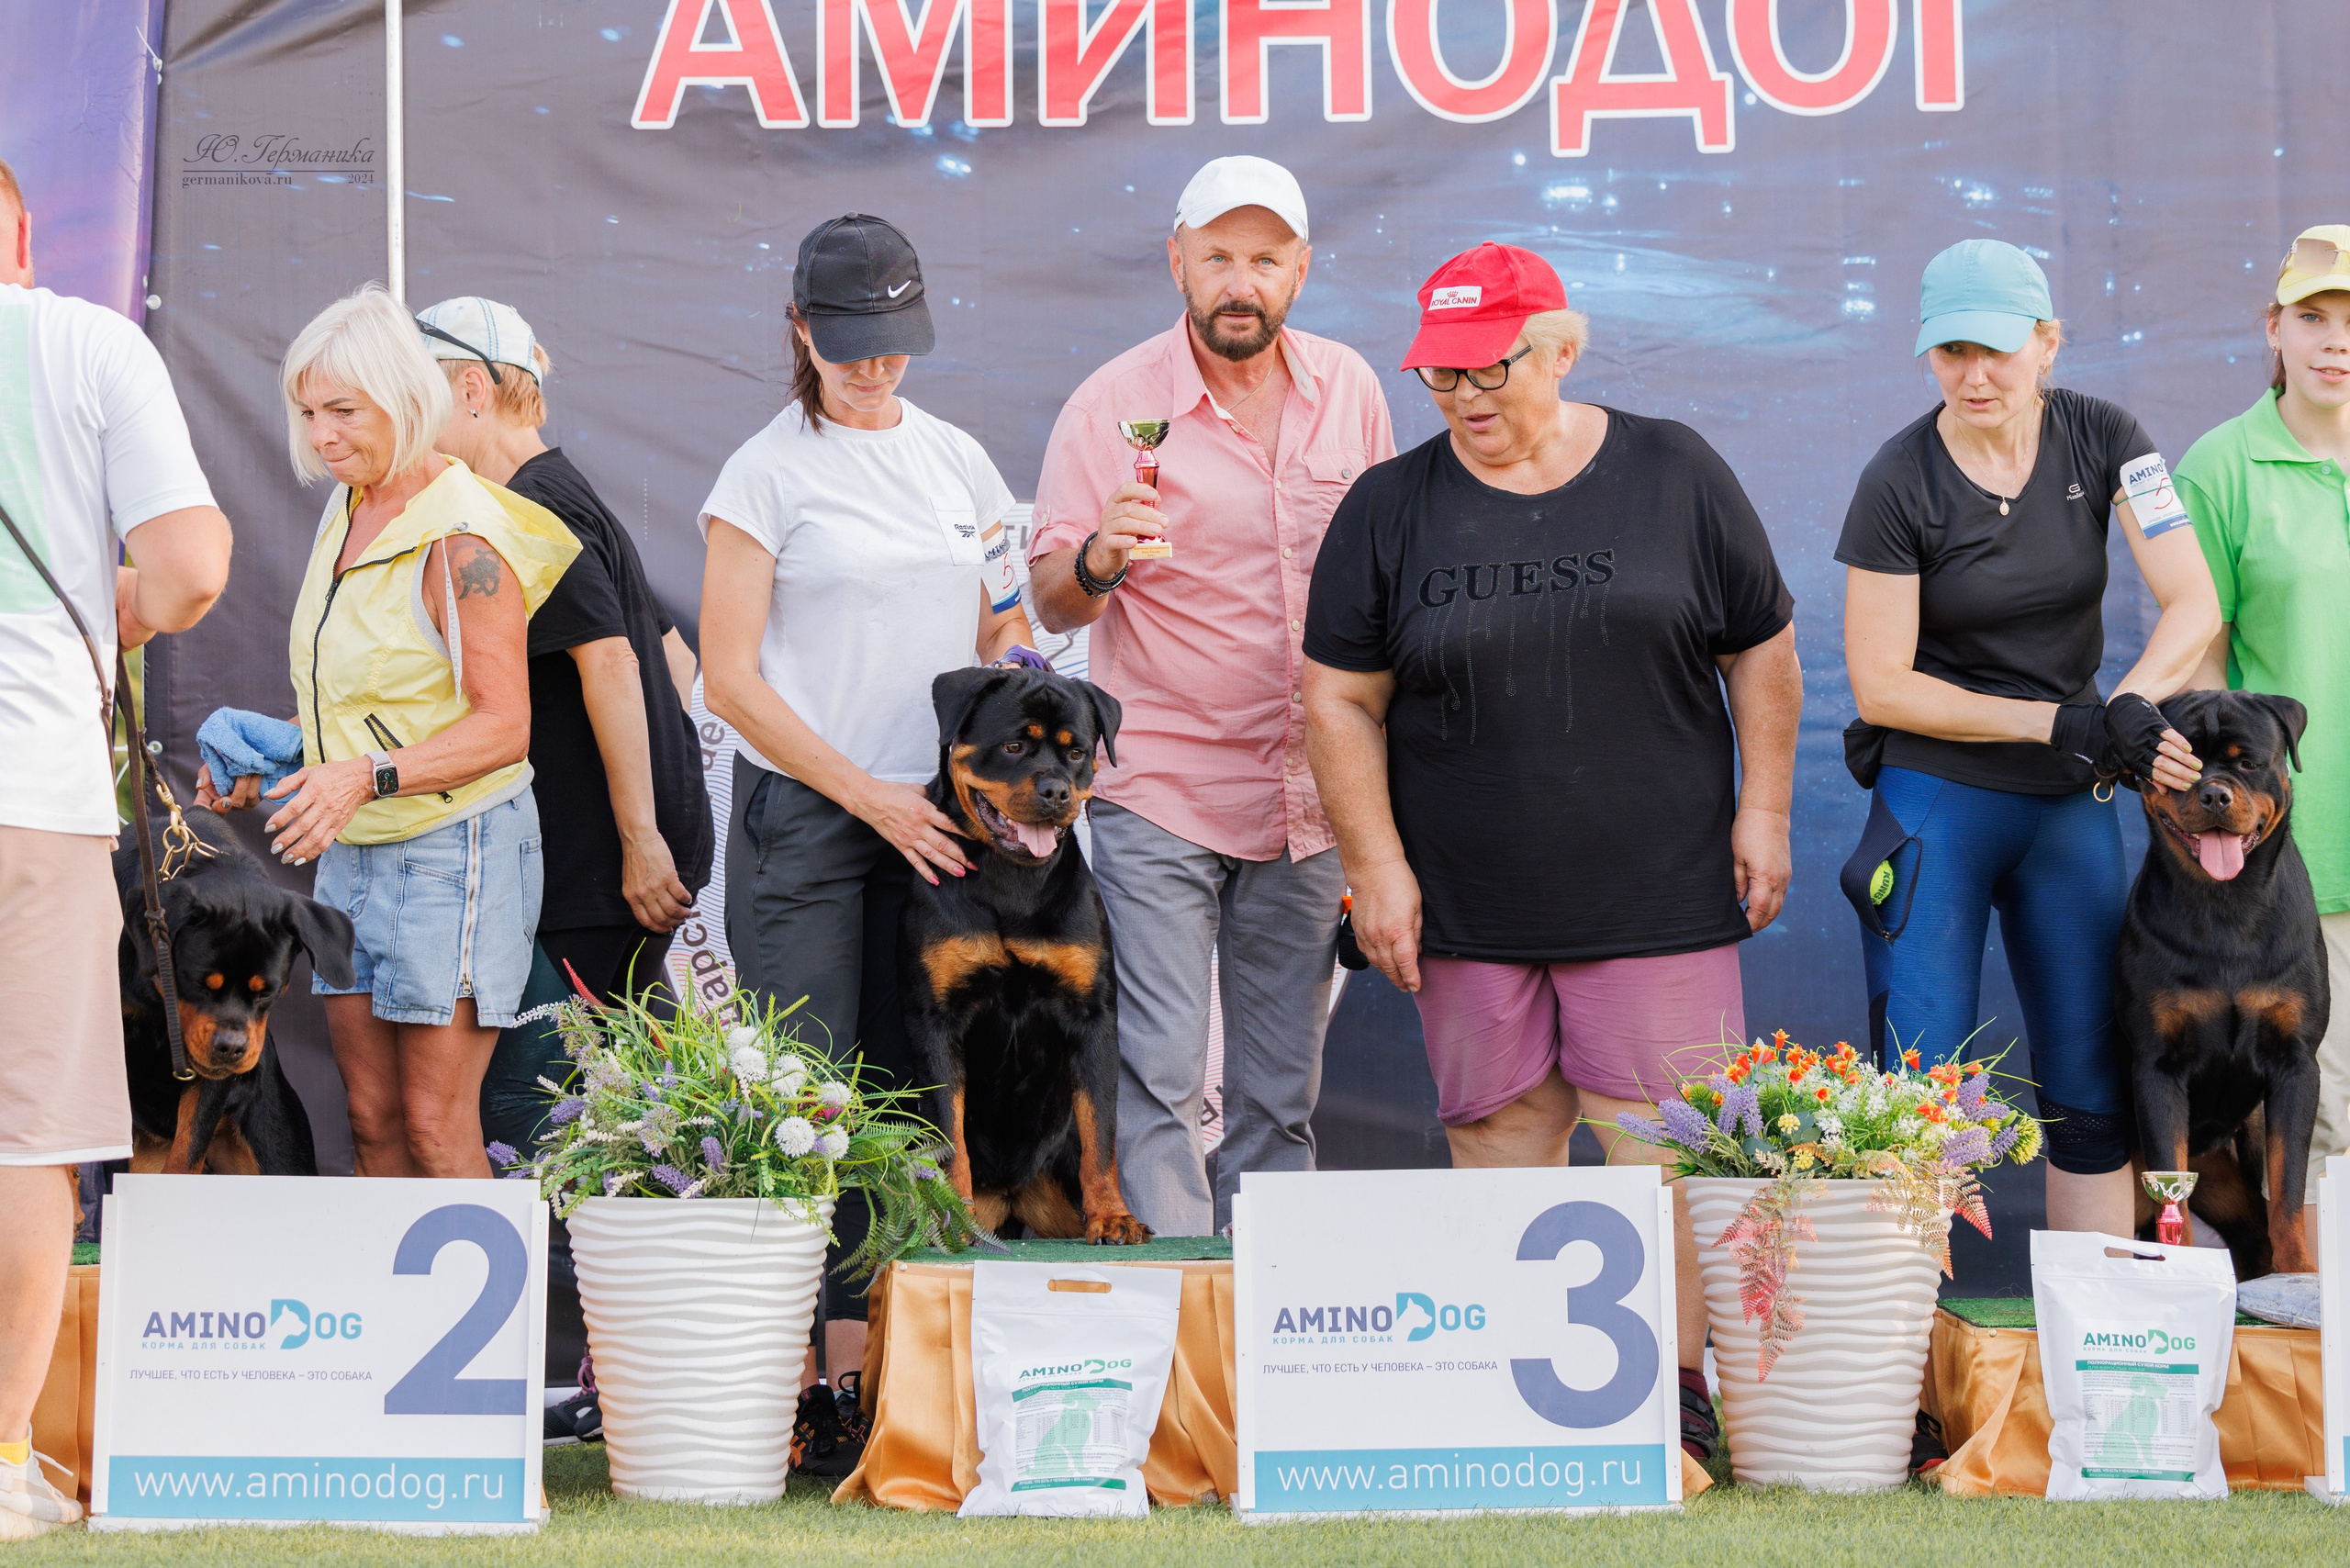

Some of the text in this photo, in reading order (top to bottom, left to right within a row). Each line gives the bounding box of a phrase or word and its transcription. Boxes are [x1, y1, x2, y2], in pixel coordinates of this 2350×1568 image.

[1418, 549, 1616, 608] GUESS
[385, 1204, 528, 1416] 2
[1511, 1200, 1659, 1429] 3
[192, 1342, 217, 1350] ДЛЯ
[224, 1342, 266, 1350] СОБАК
[1353, 1335, 1393, 1343] СОБАК
[130, 1370, 177, 1381] ЛУЧШЕЕ,
[181, 1370, 200, 1380] ЧТО
[204, 1370, 229, 1380] ЕСТЬ
[232, 1370, 239, 1380] У
[241, 1371, 296, 1380] ЧЕЛОВЕКА
[308, 1371, 328, 1381] ЭТО
[330, 1372, 373, 1381] СОБАКА
[1263, 1364, 1309, 1374] ЛУЧШЕЕ,
[1312, 1364, 1331, 1373] ЧТО
[1335, 1363, 1359, 1372] ЕСТЬ
[1361, 1363, 1368, 1372] У
[1371, 1362, 1424, 1372] ЧЕЛОВЕКА
[1435, 1362, 1454, 1371] ЭТО
[1458, 1361, 1498, 1371] СОБАКА
[134, 1462, 504, 1509] www.aminodog.ru
[1277, 1449, 1641, 1496] www.aminodog.ru
